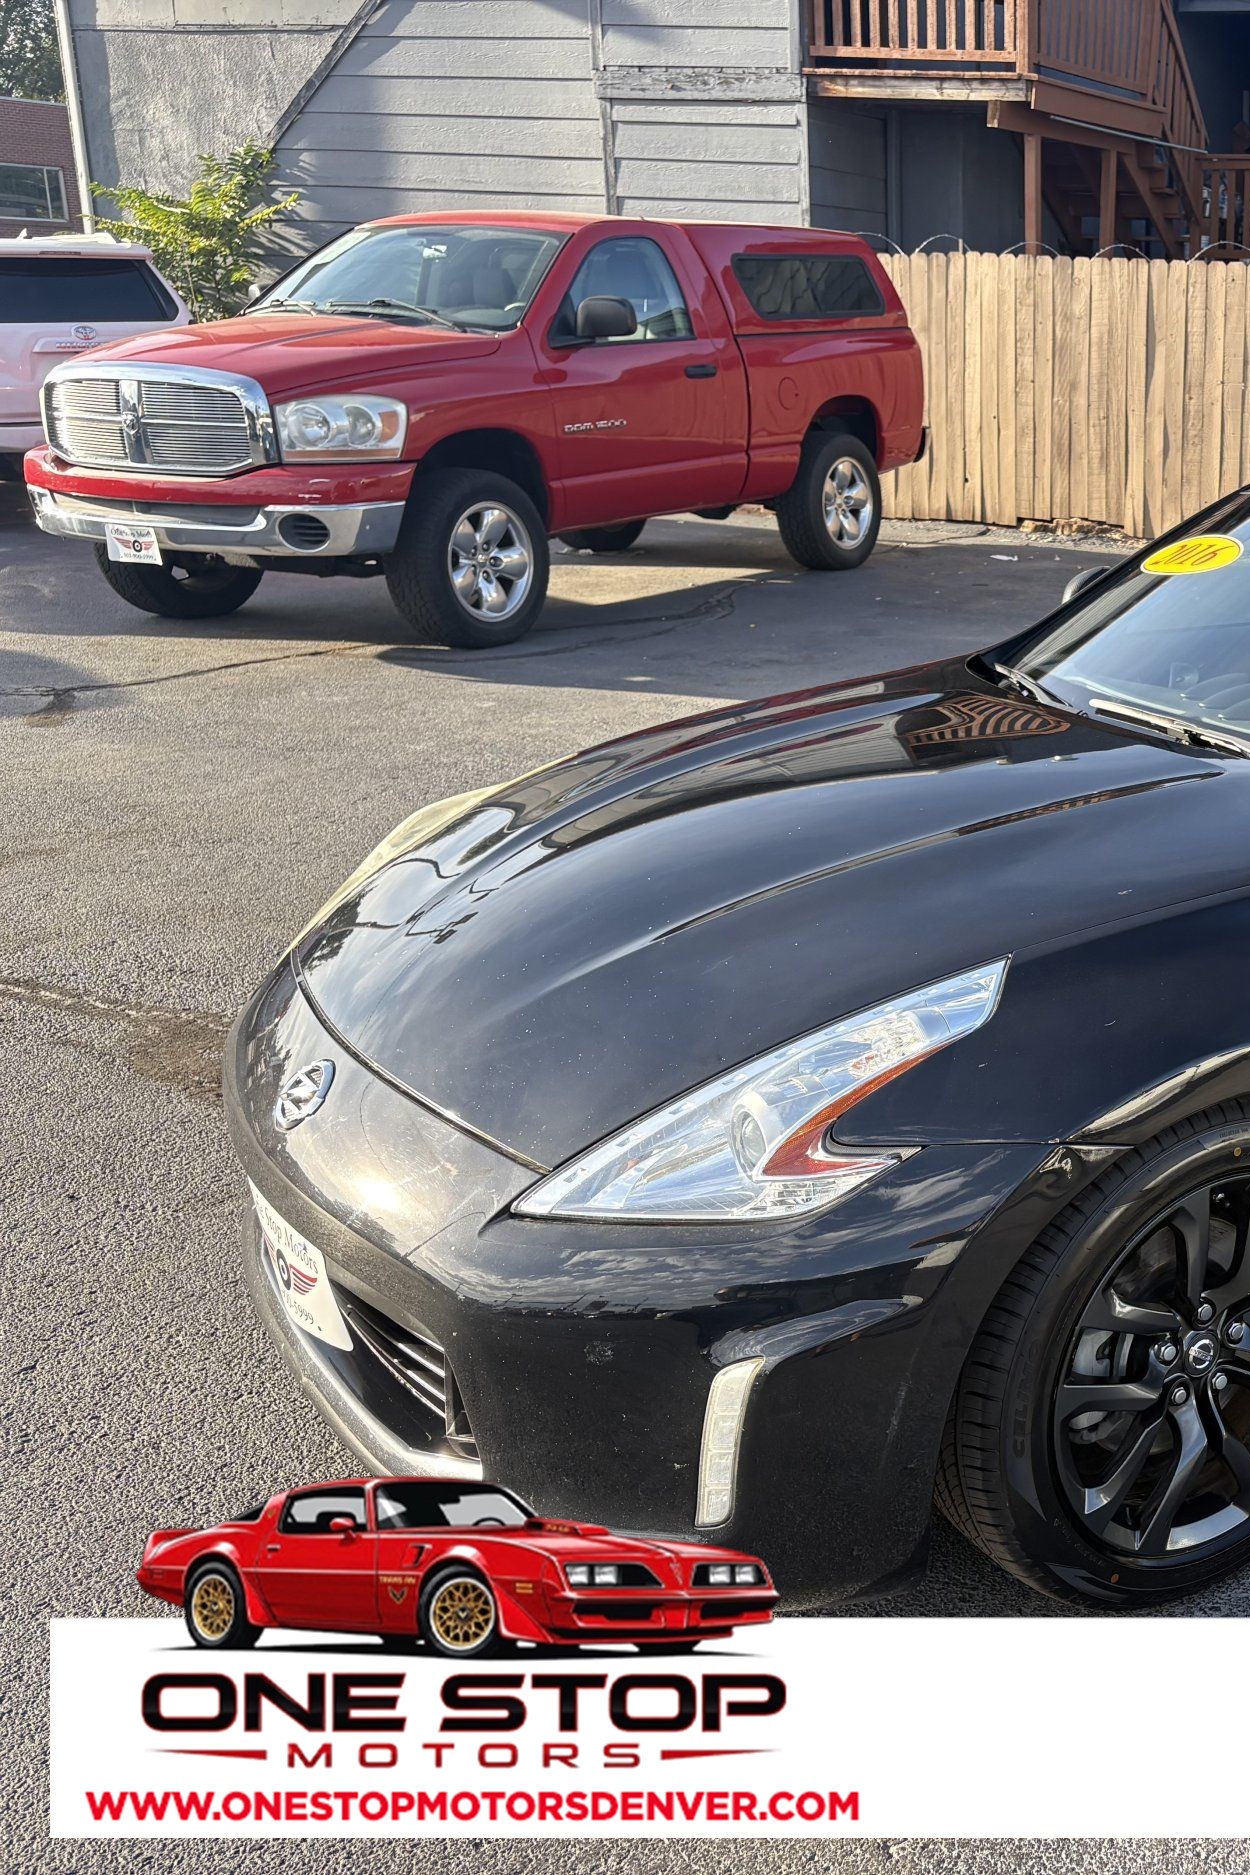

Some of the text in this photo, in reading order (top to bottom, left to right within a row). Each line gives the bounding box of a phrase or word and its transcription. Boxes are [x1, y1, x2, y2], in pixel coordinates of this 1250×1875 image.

[1149, 543, 1236, 566] 2016
[264, 1206, 281, 1244] Stop
[284, 1227, 319, 1275] Motors
